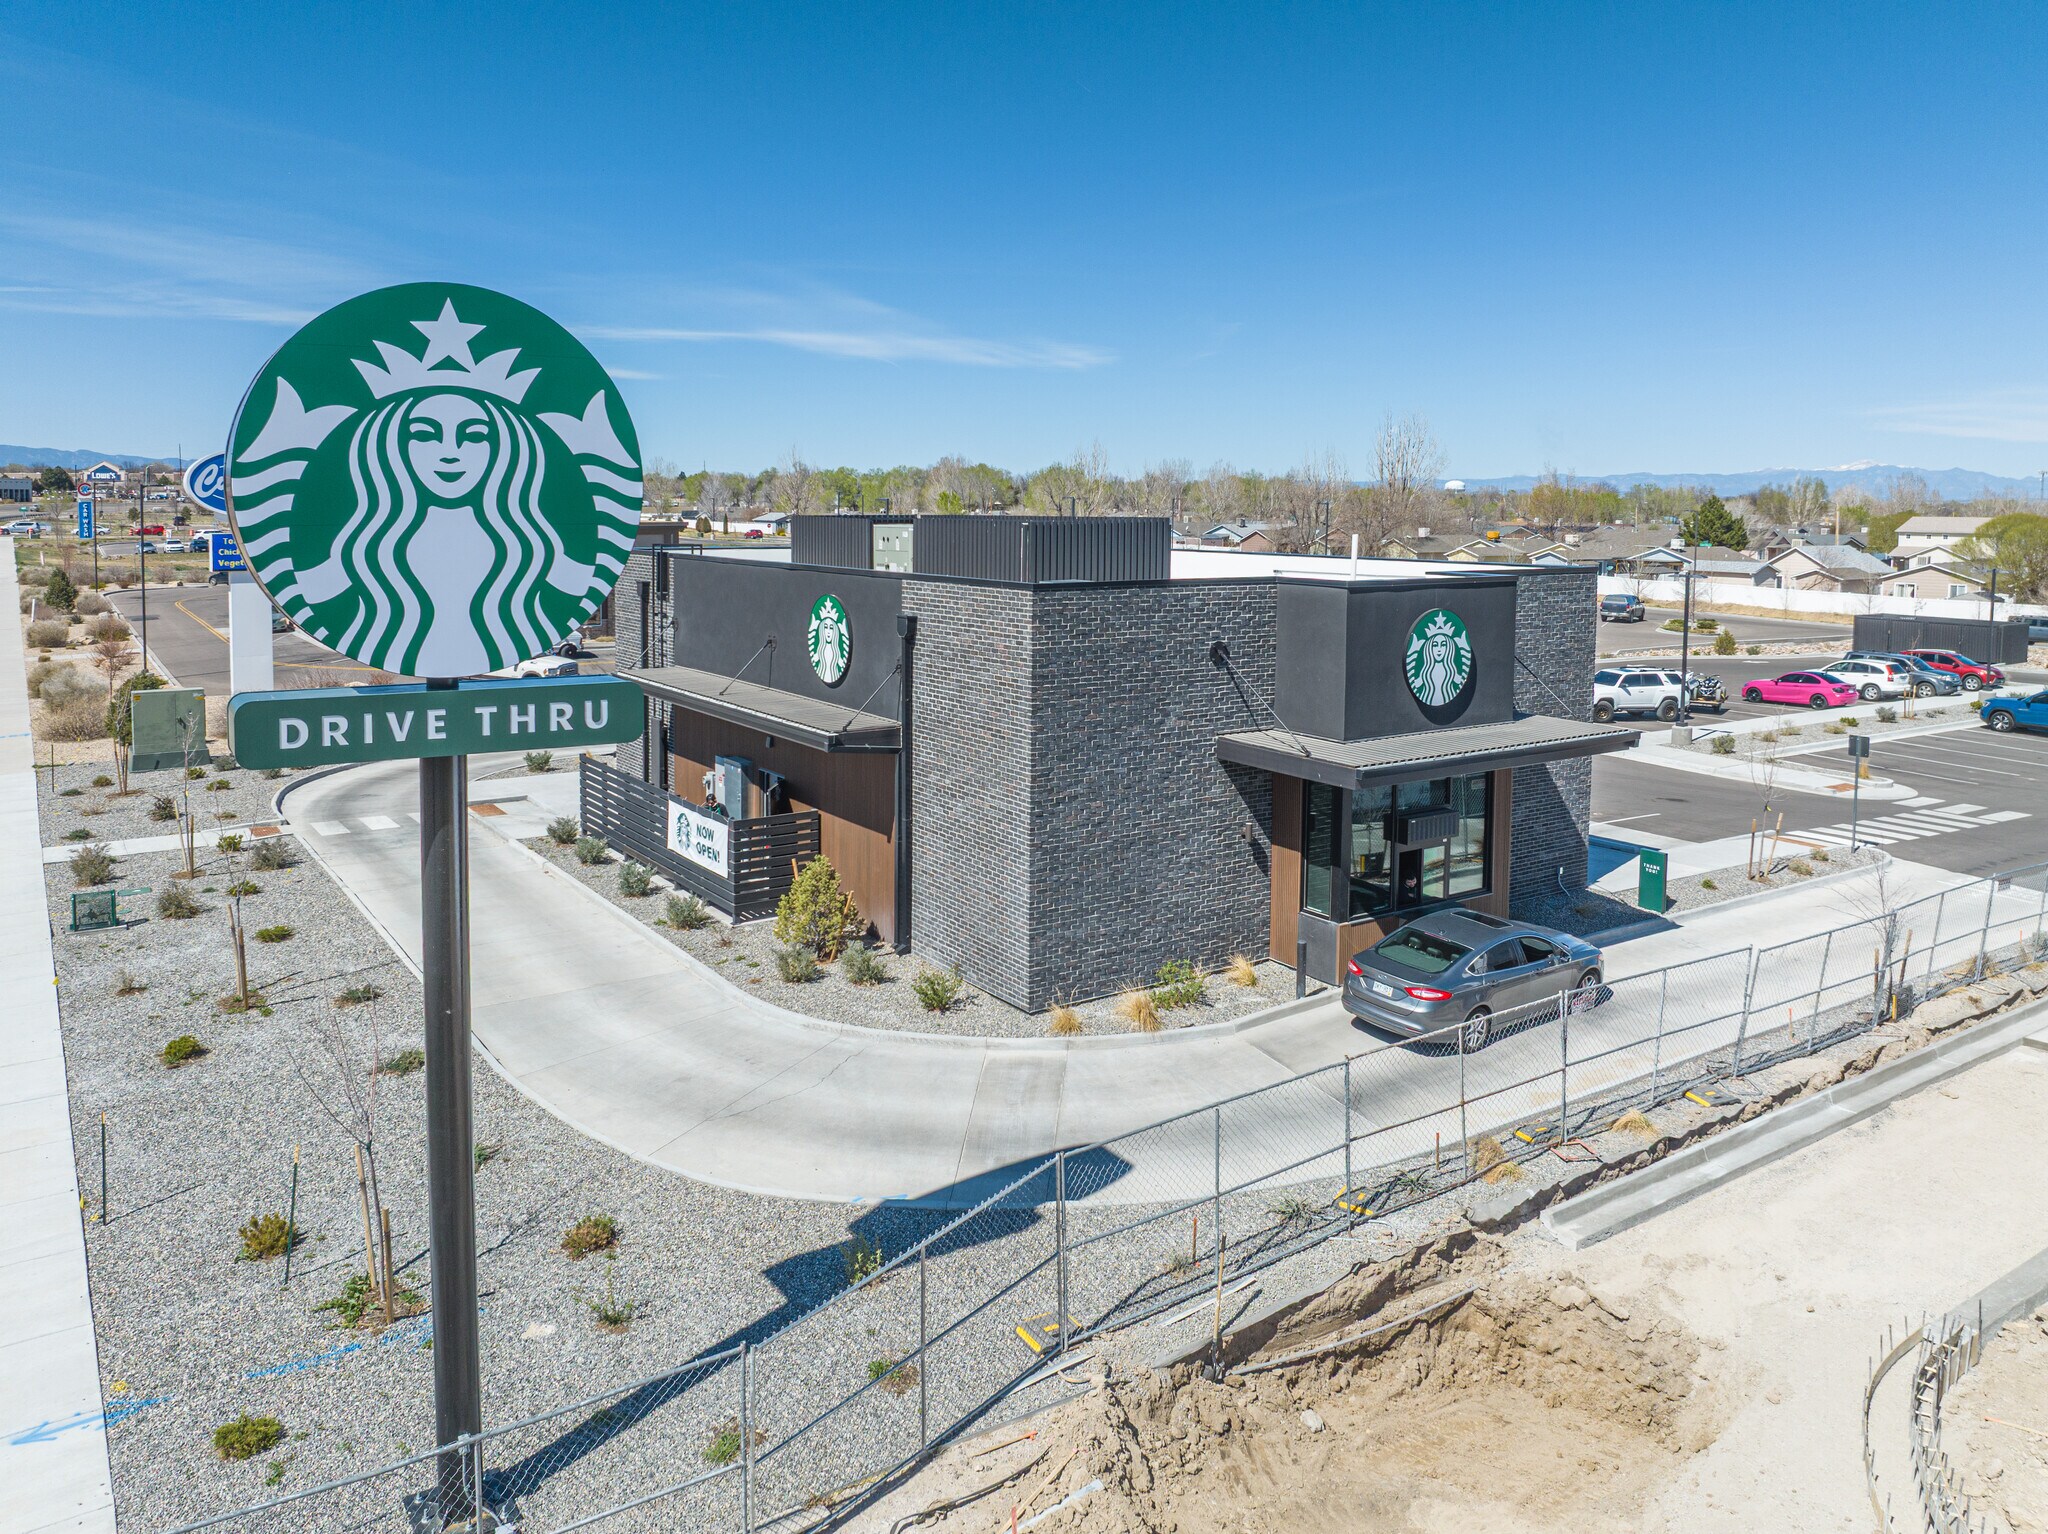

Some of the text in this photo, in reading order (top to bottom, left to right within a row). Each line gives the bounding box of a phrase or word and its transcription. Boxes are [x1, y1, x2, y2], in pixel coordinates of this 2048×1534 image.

[222, 537, 237, 545] To
[278, 699, 608, 750] DRIVE THRU
[696, 823, 715, 843] NOW
[695, 841, 720, 864] OPEN!
